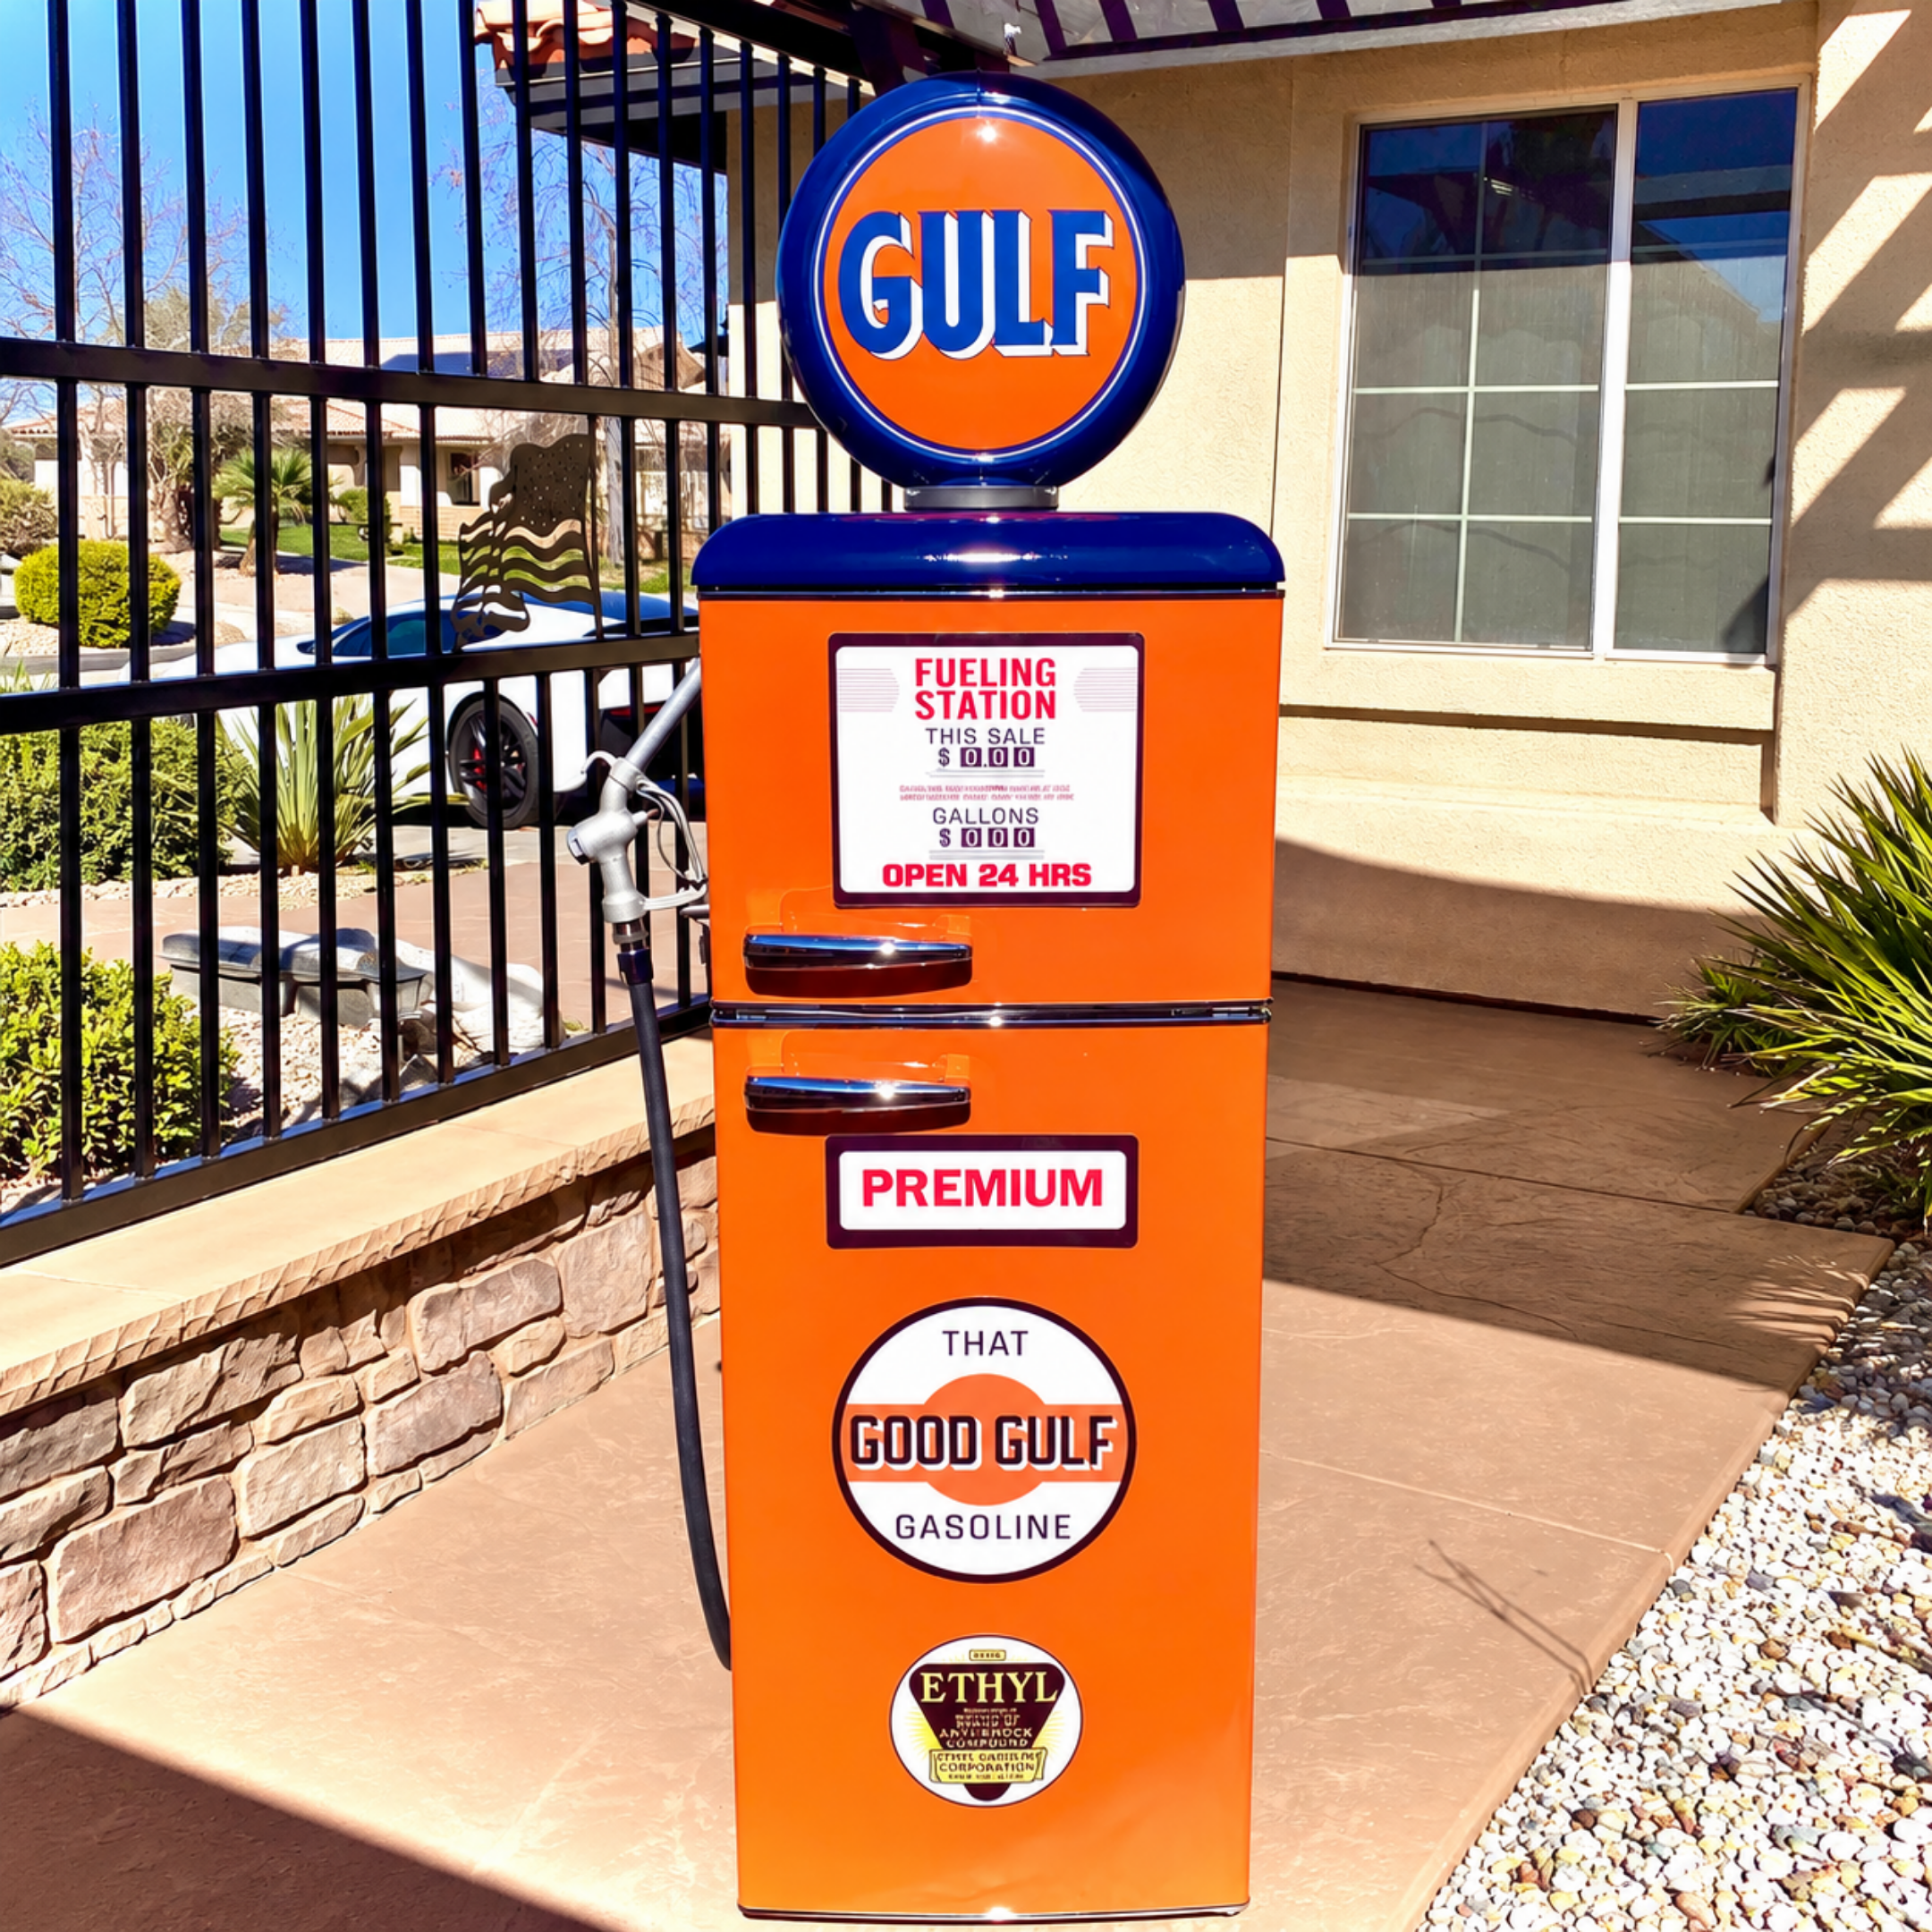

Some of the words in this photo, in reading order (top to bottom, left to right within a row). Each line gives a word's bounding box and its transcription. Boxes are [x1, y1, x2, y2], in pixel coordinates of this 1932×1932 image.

[838, 209, 1114, 360] GULF
[915, 658, 1056, 687] FUELING
[914, 691, 1056, 720] STATION
[926, 728, 977, 744] THIS
[988, 728, 1045, 744] SALE
[933, 808, 1039, 824] GALLONS
[883, 864, 968, 886] OPEN
[979, 864, 1020, 886] 24
[1030, 863, 1092, 886] HRS
[863, 1169, 1103, 1207] PREMIUM
[943, 1331, 1029, 1356] THAT
[851, 1415, 982, 1470] GOOD
[996, 1415, 1118, 1470] GULF
[895, 1514, 1072, 1539] GASOLINE
[920, 1672, 1058, 1703] ETHYL
